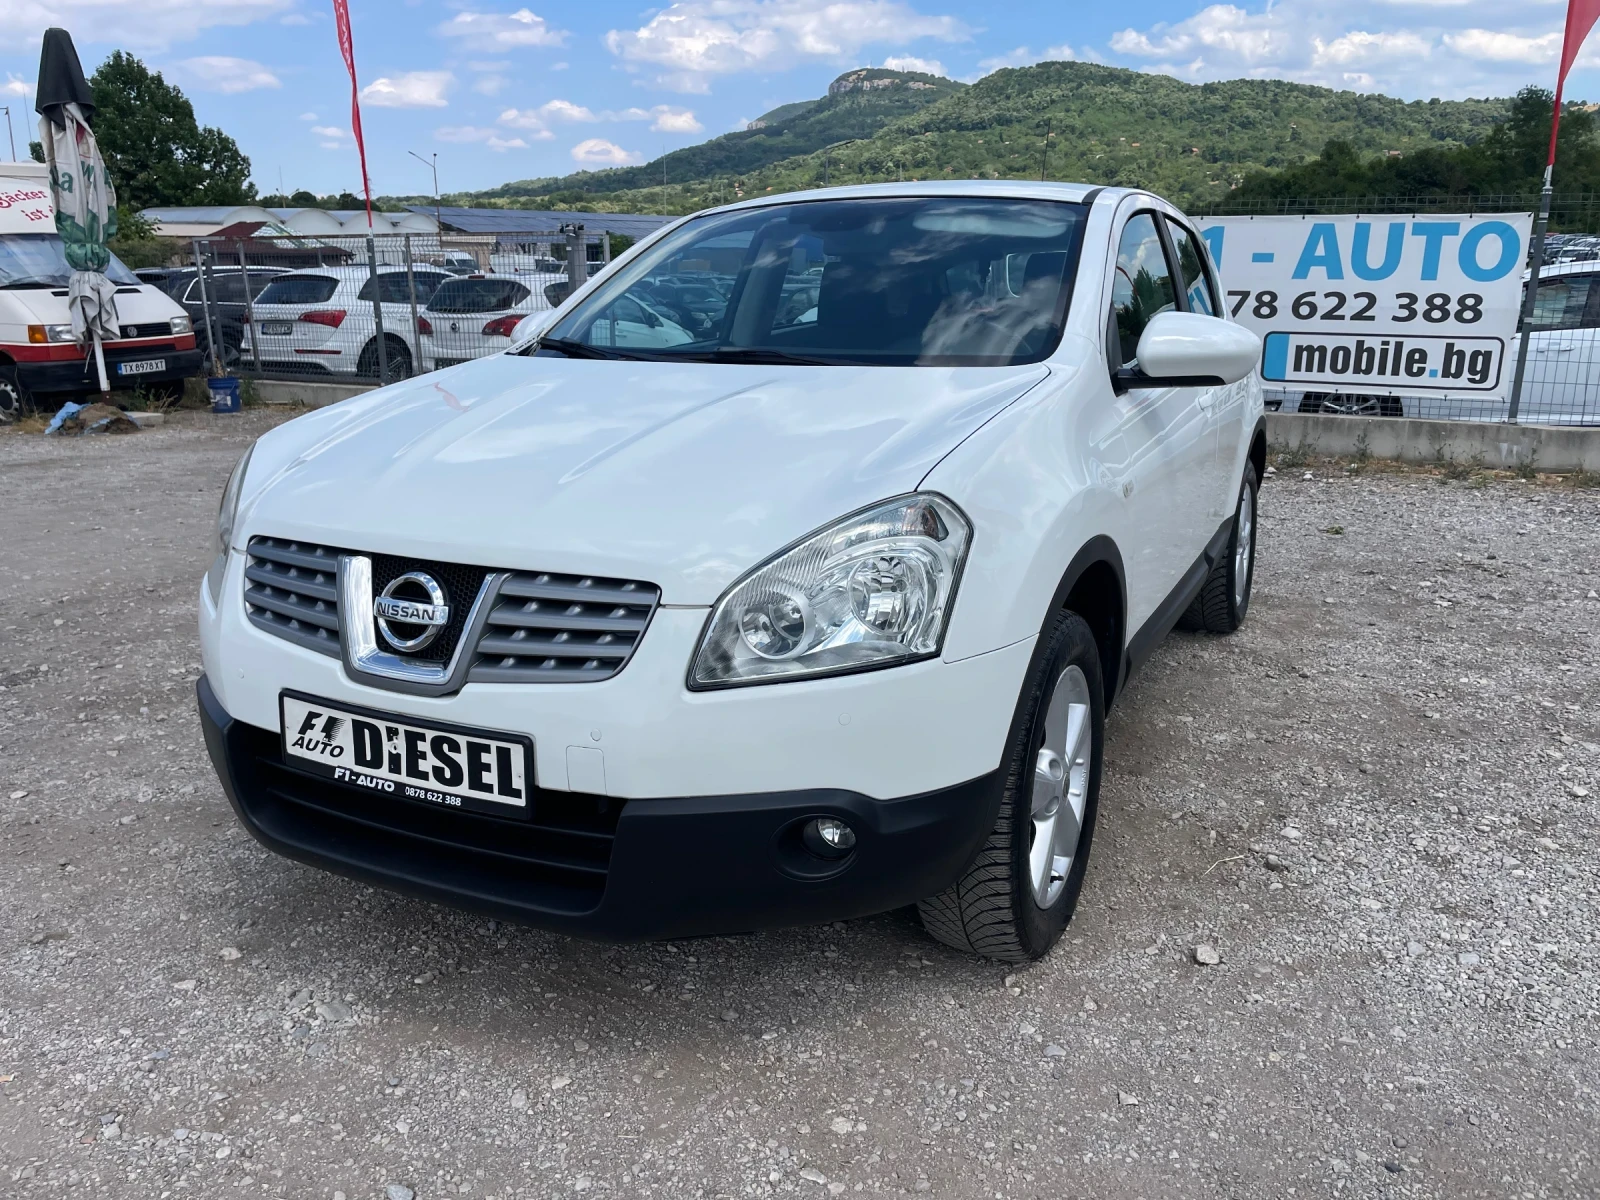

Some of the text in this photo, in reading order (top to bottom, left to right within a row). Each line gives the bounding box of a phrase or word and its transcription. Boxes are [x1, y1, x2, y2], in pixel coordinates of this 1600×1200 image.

[1291, 220, 1521, 283] AUTO
[1291, 291, 1378, 321] 622
[1391, 292, 1484, 324] 388
[1292, 340, 1493, 384] mobile.bg
[376, 601, 435, 621] NISSAN
[292, 735, 344, 758] AUTO
[351, 718, 522, 800] DIESEL
[405, 786, 462, 807] 0878 622 388
